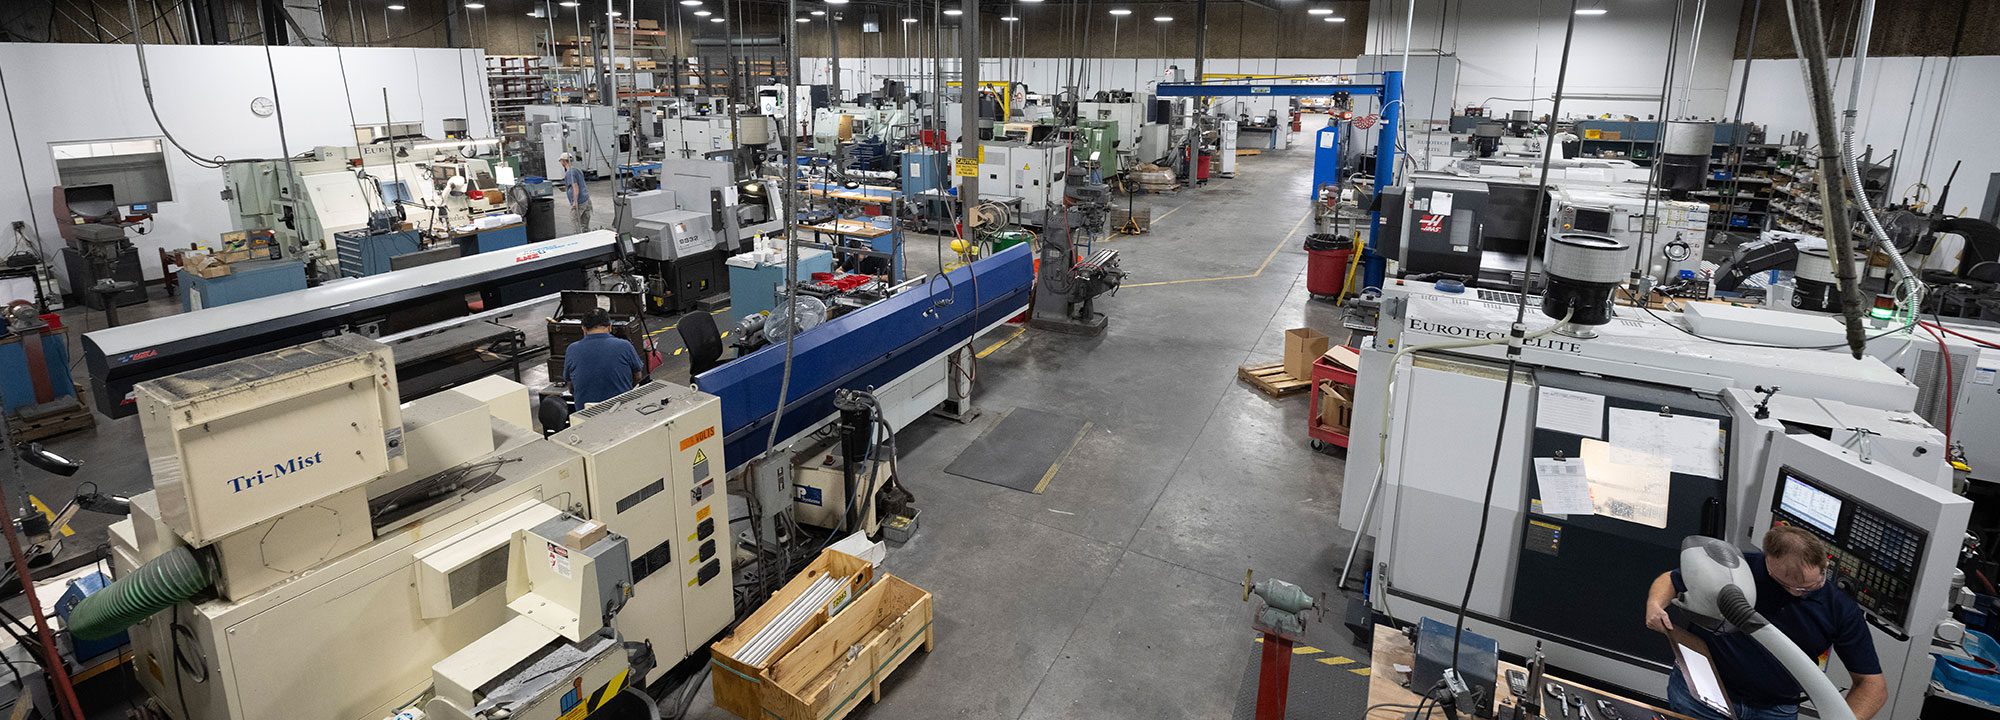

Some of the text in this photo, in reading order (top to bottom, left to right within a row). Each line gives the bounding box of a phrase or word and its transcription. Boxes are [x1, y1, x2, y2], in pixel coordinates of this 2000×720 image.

[1409, 318, 1582, 354] EUROTEC ELITE
[226, 451, 322, 494] Tri-Mist
